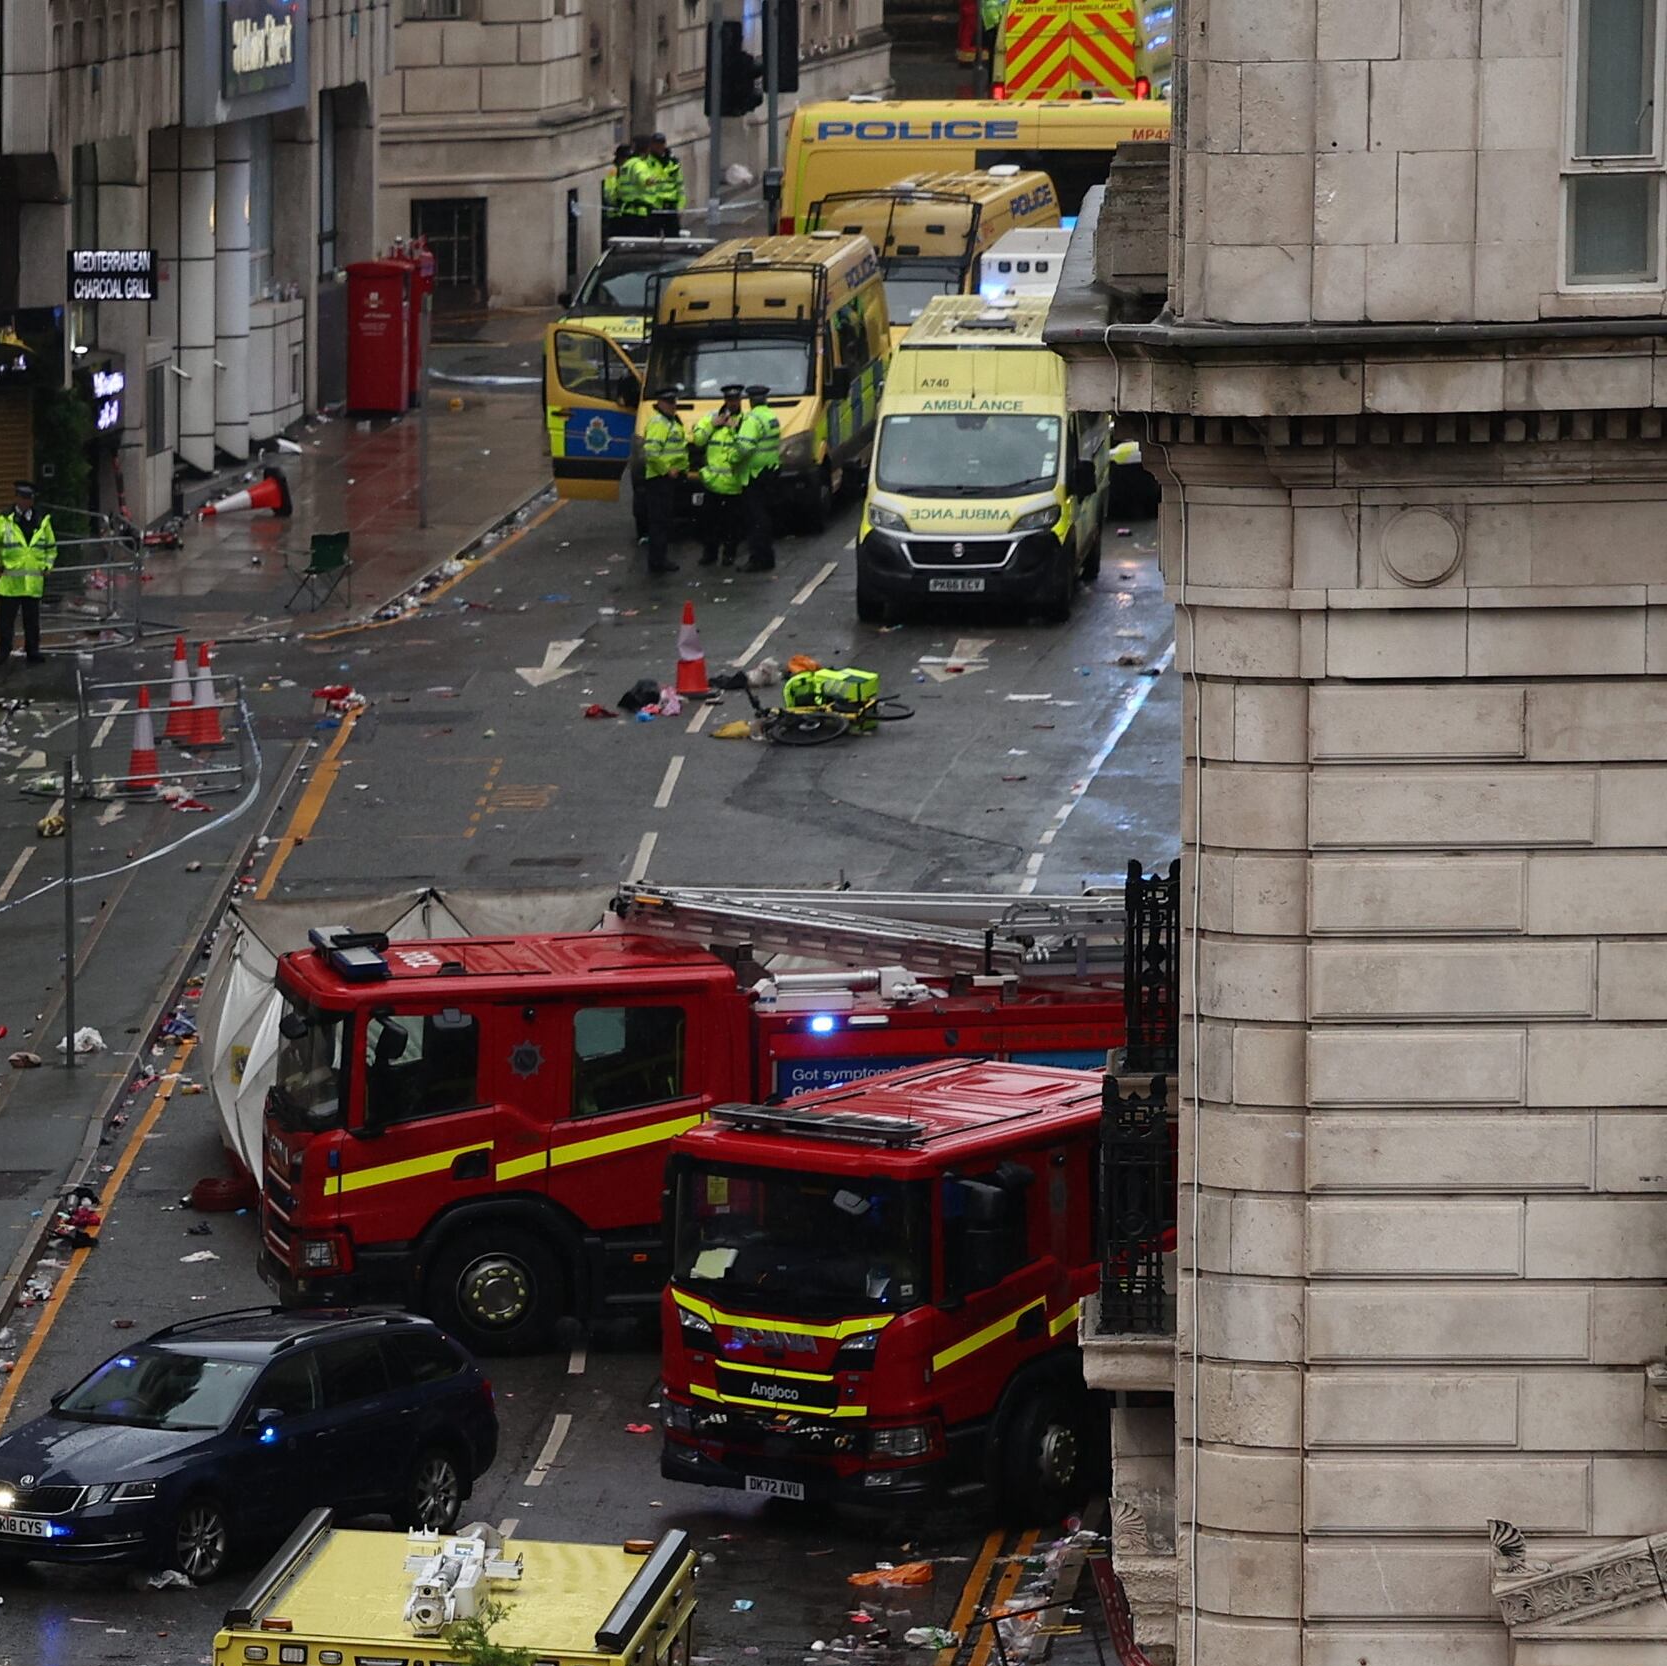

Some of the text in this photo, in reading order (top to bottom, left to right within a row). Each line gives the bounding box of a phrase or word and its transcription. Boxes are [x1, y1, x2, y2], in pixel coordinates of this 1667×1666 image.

[818, 120, 1018, 141] POLICE
[1010, 184, 1052, 218] POLICE
[73, 250, 151, 272] MEDITERRANEAN
[74, 277, 151, 299] CHARCOAL GRILL
[921, 378, 949, 388] A740
[922, 400, 1023, 412] AMBULANCE
[792, 1067, 819, 1081] Got
[750, 1381, 799, 1401] Angloco
[750, 1478, 800, 1497] DK72 AVU
[20, 1520, 42, 1534] CYS
